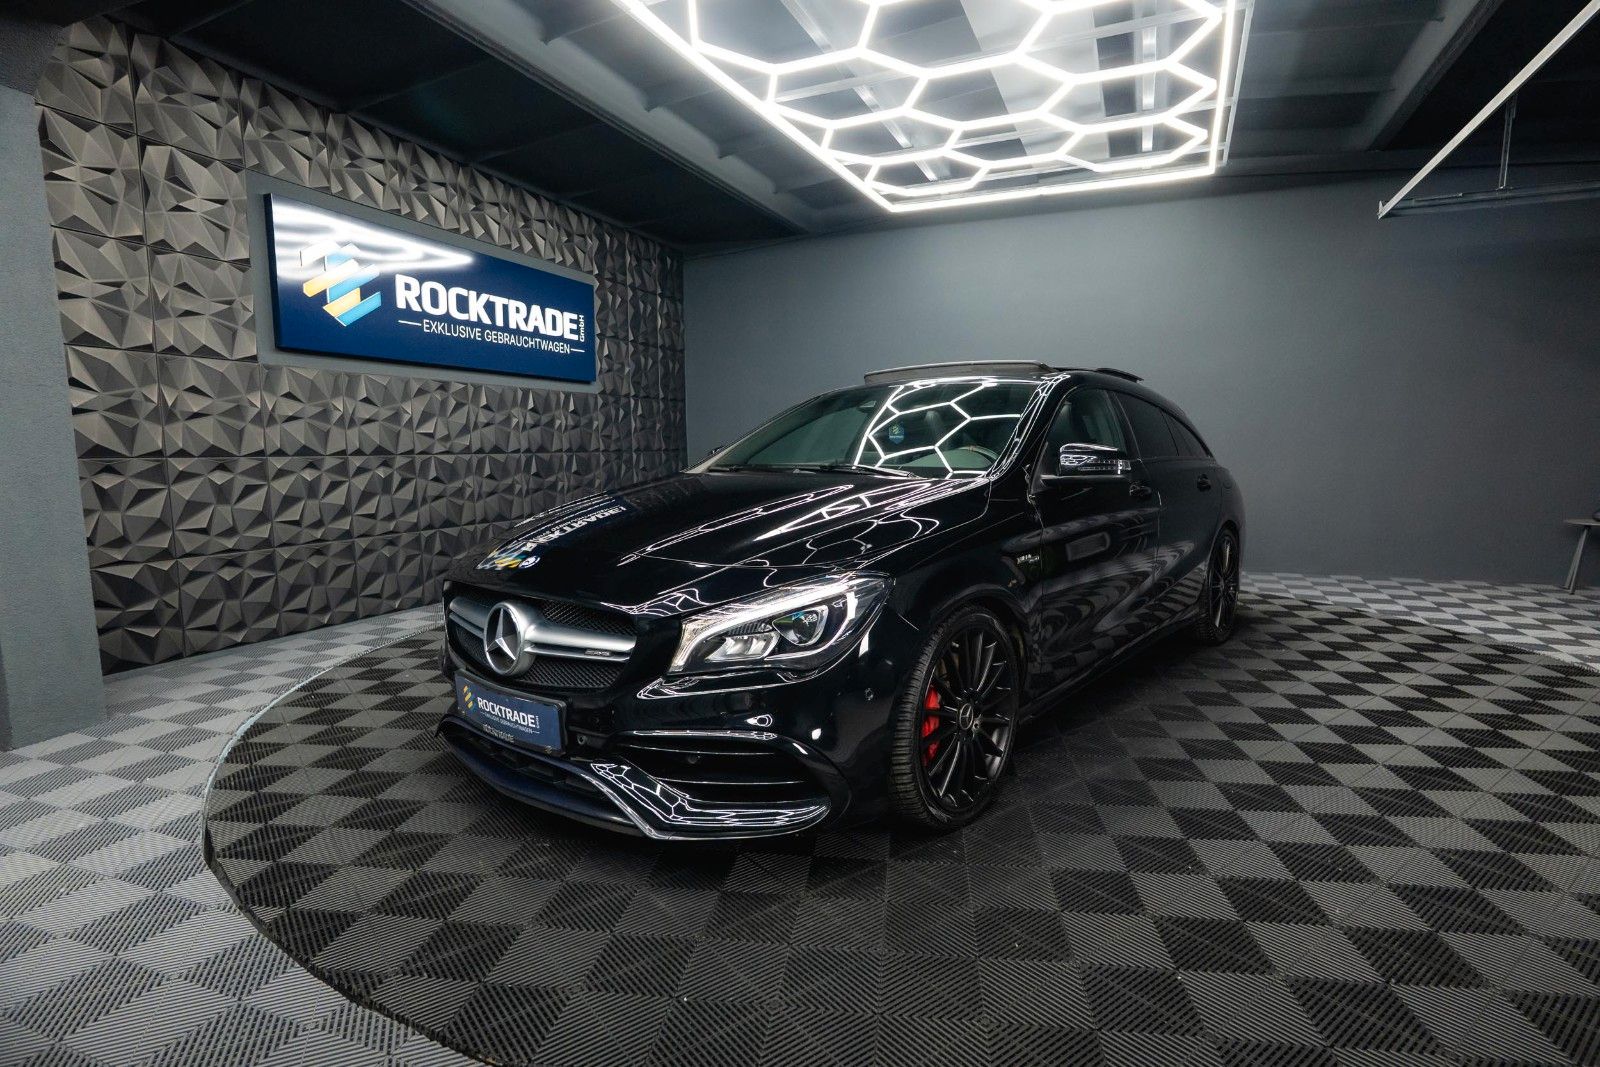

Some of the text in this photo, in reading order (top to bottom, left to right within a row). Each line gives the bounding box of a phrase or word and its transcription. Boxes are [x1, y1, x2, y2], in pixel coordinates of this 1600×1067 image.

[395, 273, 579, 341] ROCKTRADE
[423, 319, 571, 355] EXKLUSIVE GEBRAUCHTWAGEN
[477, 696, 536, 728] ROCKTRADE
